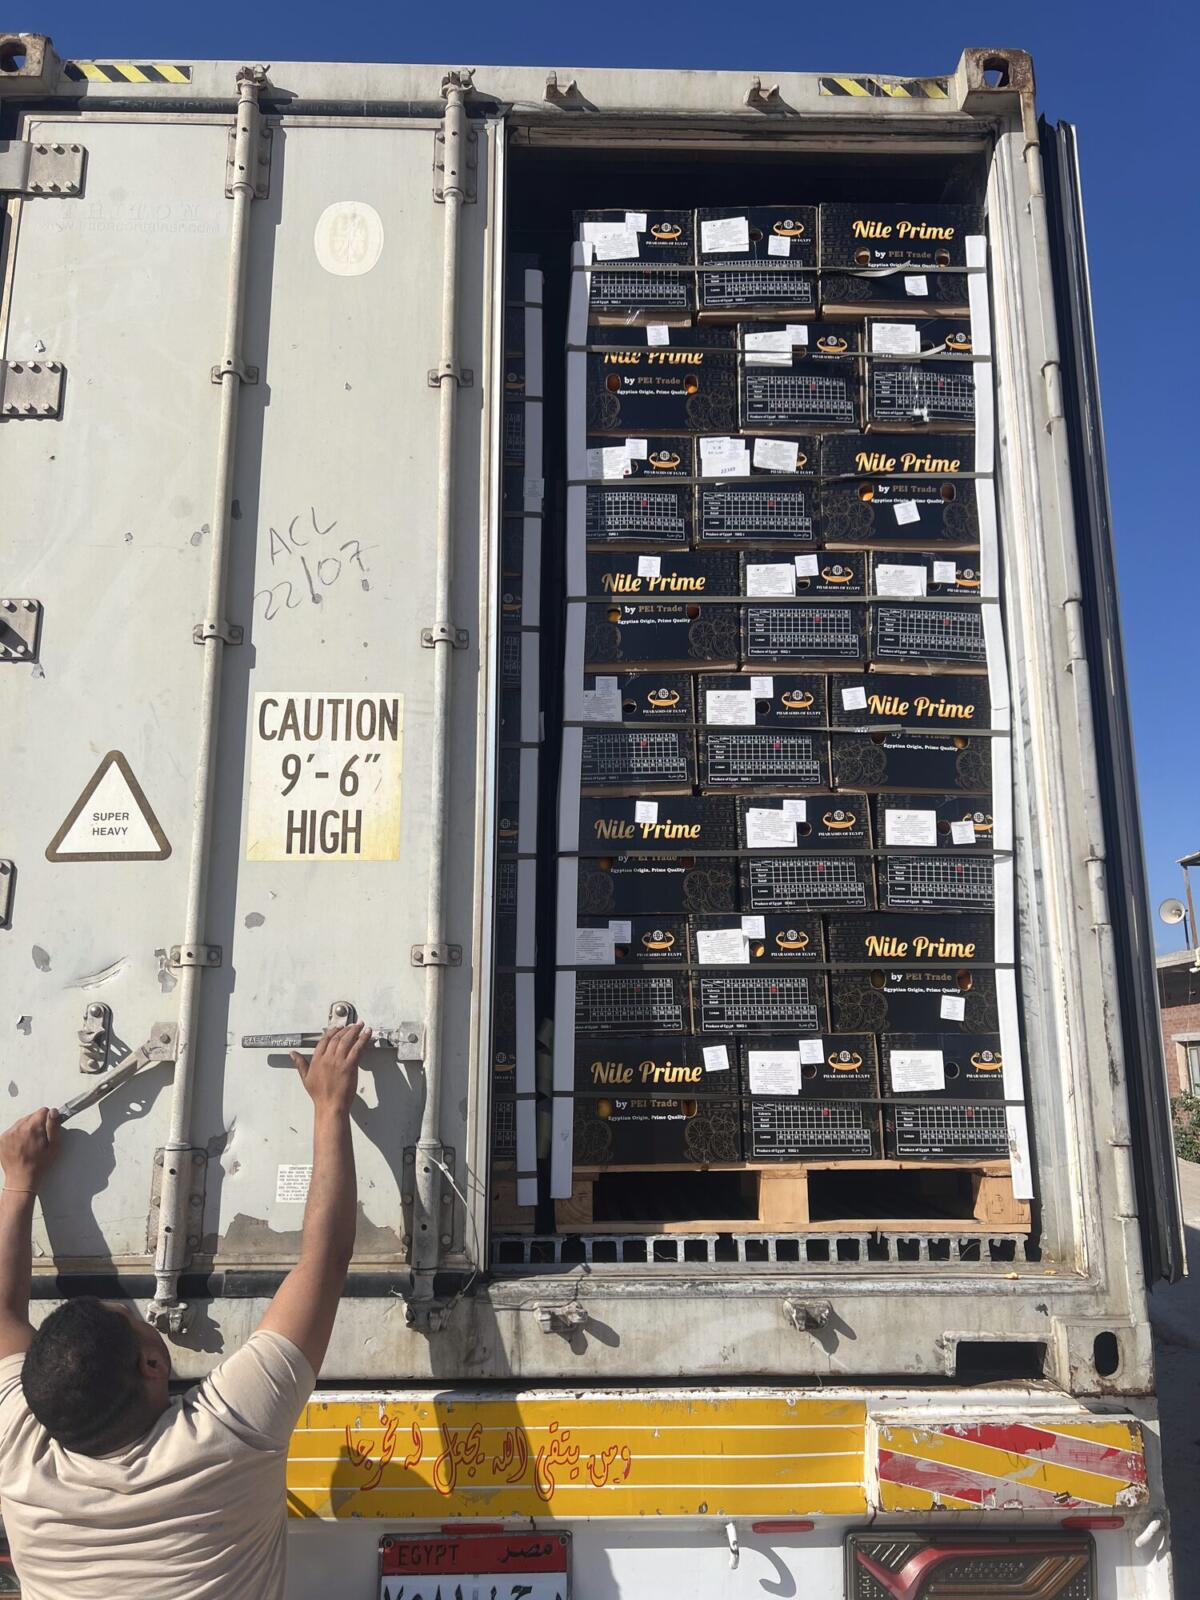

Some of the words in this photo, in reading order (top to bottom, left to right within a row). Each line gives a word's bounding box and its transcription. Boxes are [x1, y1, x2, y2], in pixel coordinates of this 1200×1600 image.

[852, 220, 893, 239] Nile
[896, 220, 955, 240] Prime
[875, 250, 887, 259] by
[624, 377, 635, 385] by
[855, 452, 896, 472] Nile
[900, 452, 961, 473] Prime
[878, 485, 890, 494] by
[892, 485, 908, 493] PEI
[910, 485, 937, 493] Trade
[601, 573, 642, 593] Nile
[645, 572, 706, 592] Prime
[624, 606, 636, 614] by
[638, 605, 656, 613] PEI
[867, 694, 910, 716] Nile
[913, 696, 975, 719] Prime
[258, 698, 399, 742] CAUTION
[92, 812, 130, 822] SUPER
[92, 827, 129, 836] HEAVY
[285, 809, 363, 854] HIGH
[594, 819, 635, 840] Nile
[640, 819, 701, 840] Prime
[865, 935, 908, 957] Nile
[912, 936, 976, 958] Prime
[890, 973, 903, 982] by
[905, 973, 922, 981] PEI
[924, 973, 952, 981] Trade
[590, 1061, 634, 1084] Nile
[638, 1060, 703, 1084] Prime
[615, 1100, 628, 1109] by
[631, 1100, 647, 1108] PEI
[345, 1414, 400, 1492] مخرجا
[404, 1421, 424, 1470] له
[492, 1426, 528, 1483] الله
[433, 1422, 485, 1496] يجعل
[398, 1544, 460, 1567] EGYPT
[499, 1543, 553, 1563] مصر
